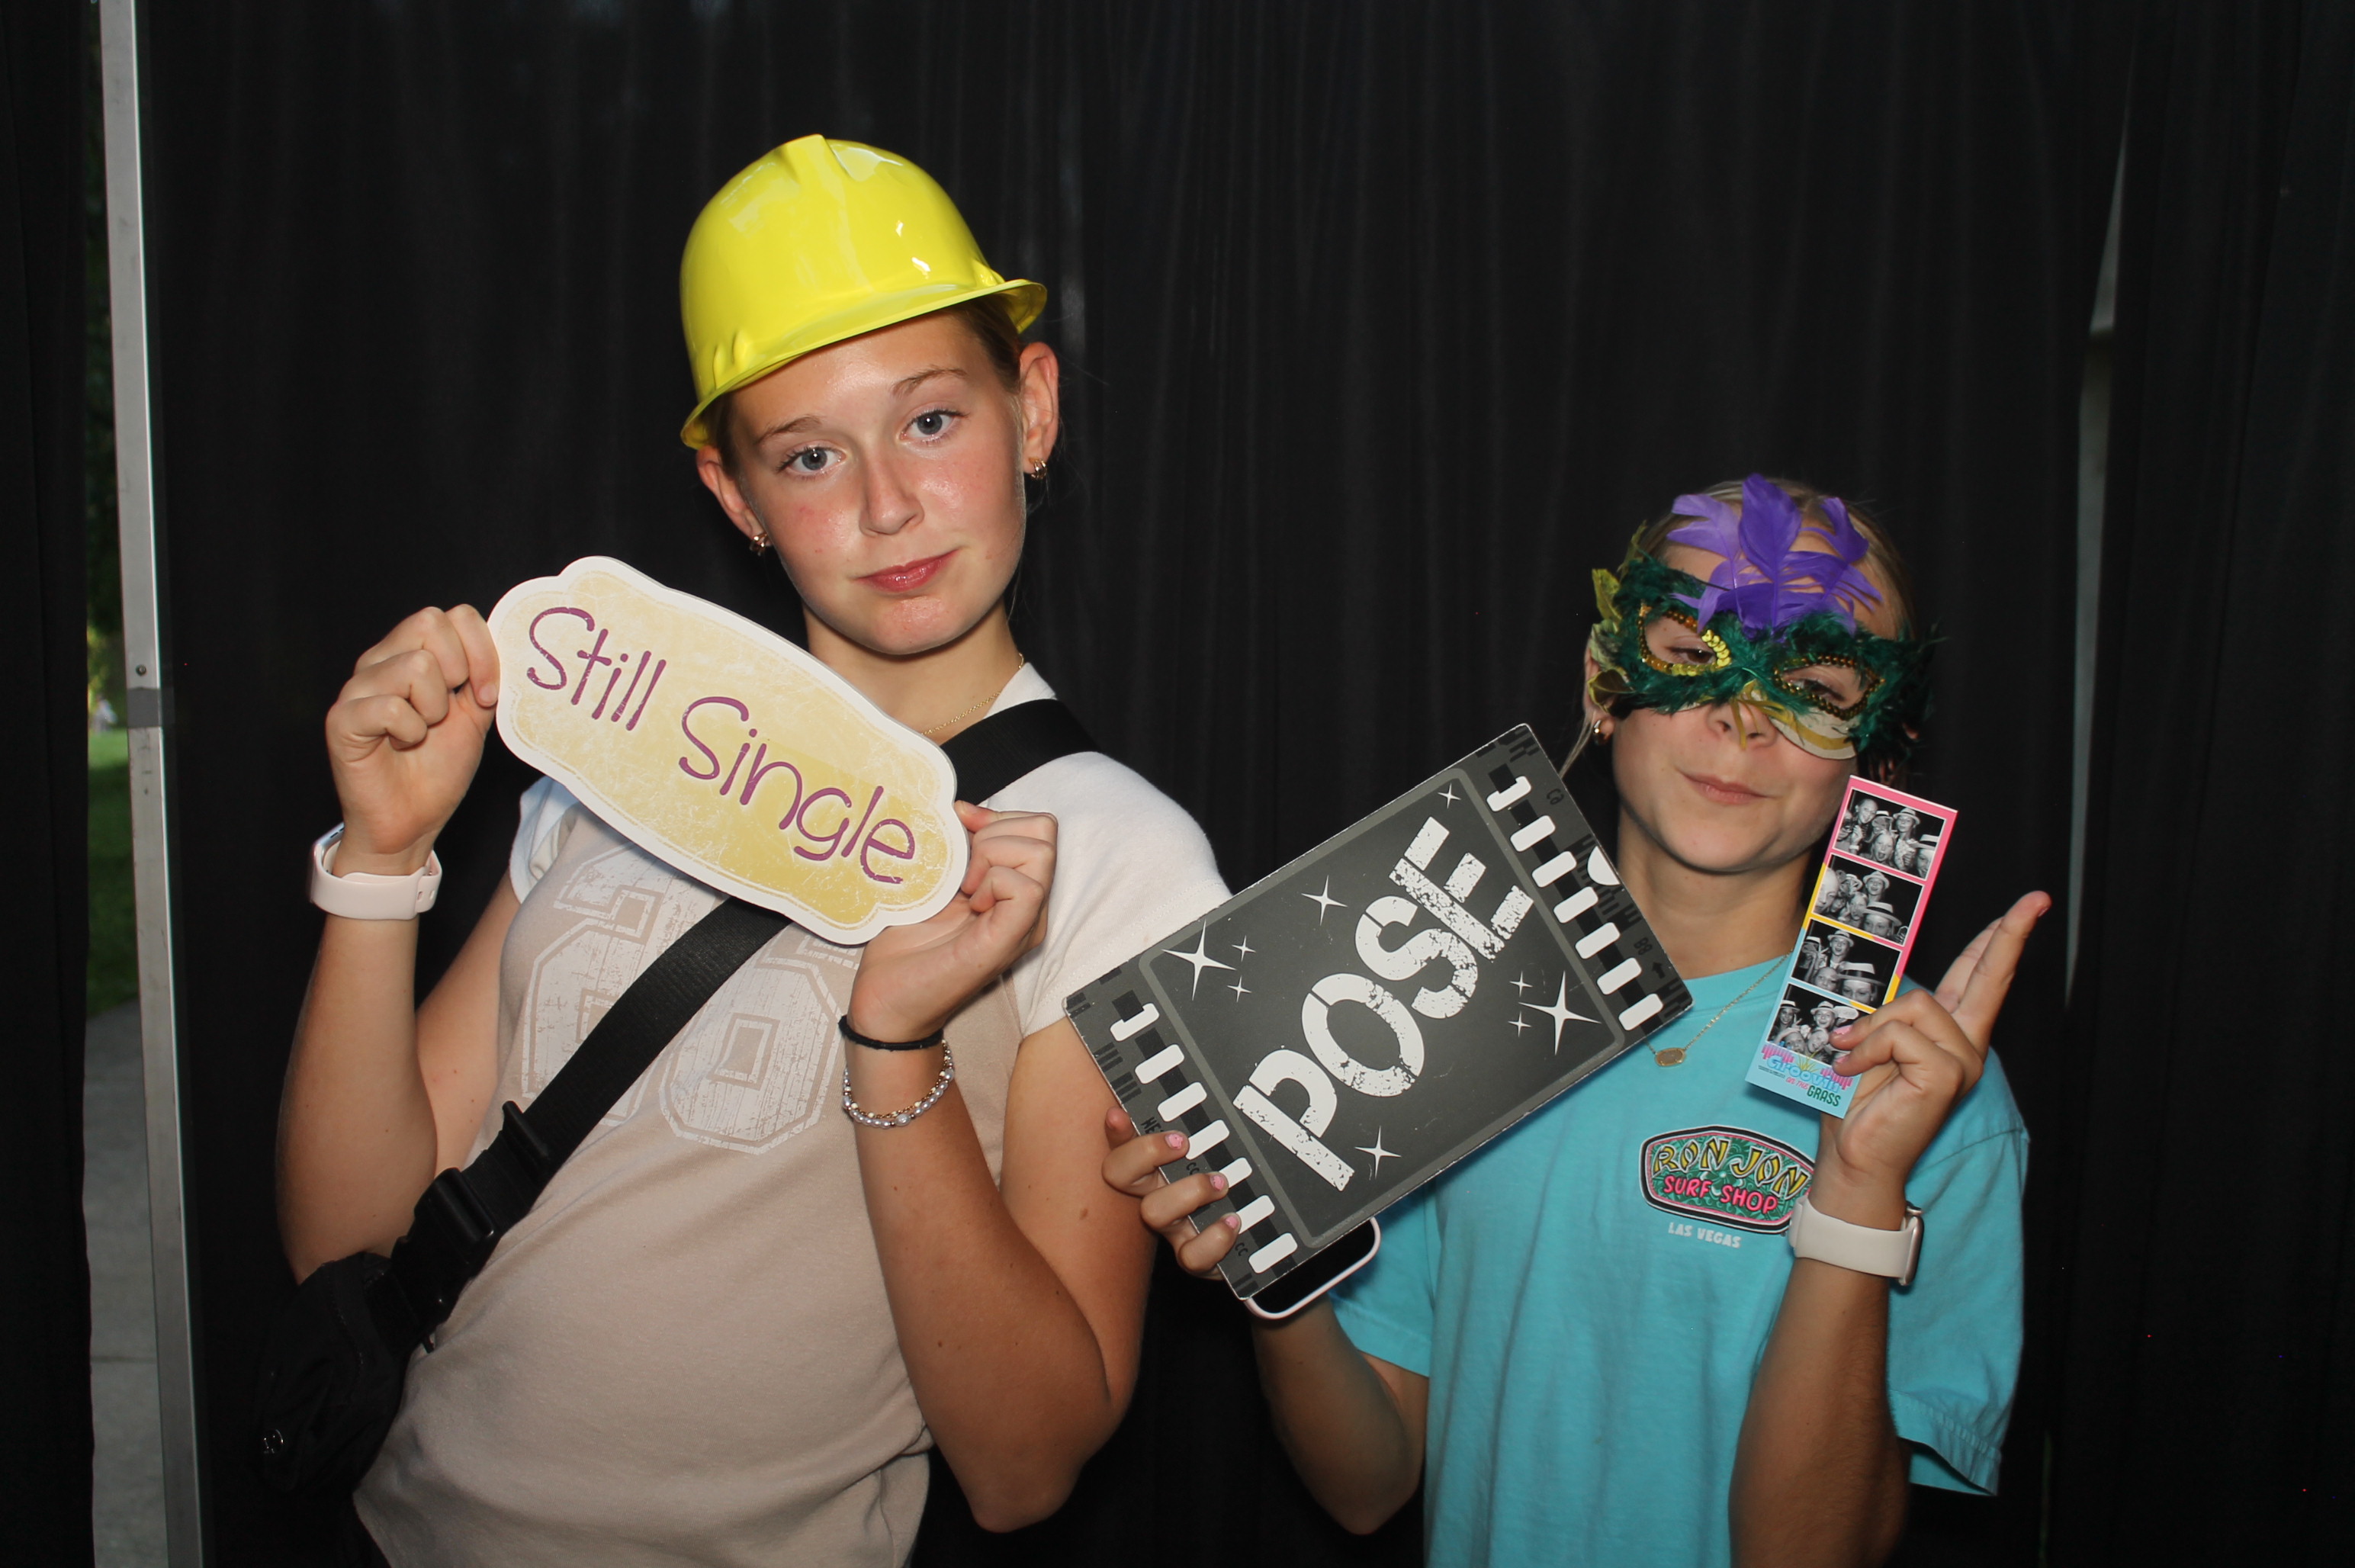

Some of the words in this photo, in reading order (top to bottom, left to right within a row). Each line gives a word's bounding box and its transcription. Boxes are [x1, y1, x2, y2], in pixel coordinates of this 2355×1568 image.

[527, 606, 667, 731] Still
[678, 696, 915, 884] Single
[1232, 816, 1534, 1193] POSE
[1807, 1084, 1842, 1107] GRASS
[1652, 1136, 1732, 1178] RON
[1730, 1145, 1811, 1200] JON
[1663, 1175, 1713, 1198] SURF
[1720, 1184, 1778, 1214] SHOP
[1668, 1222, 1693, 1237] LAS
[1697, 1227, 1742, 1249] VEGAS
